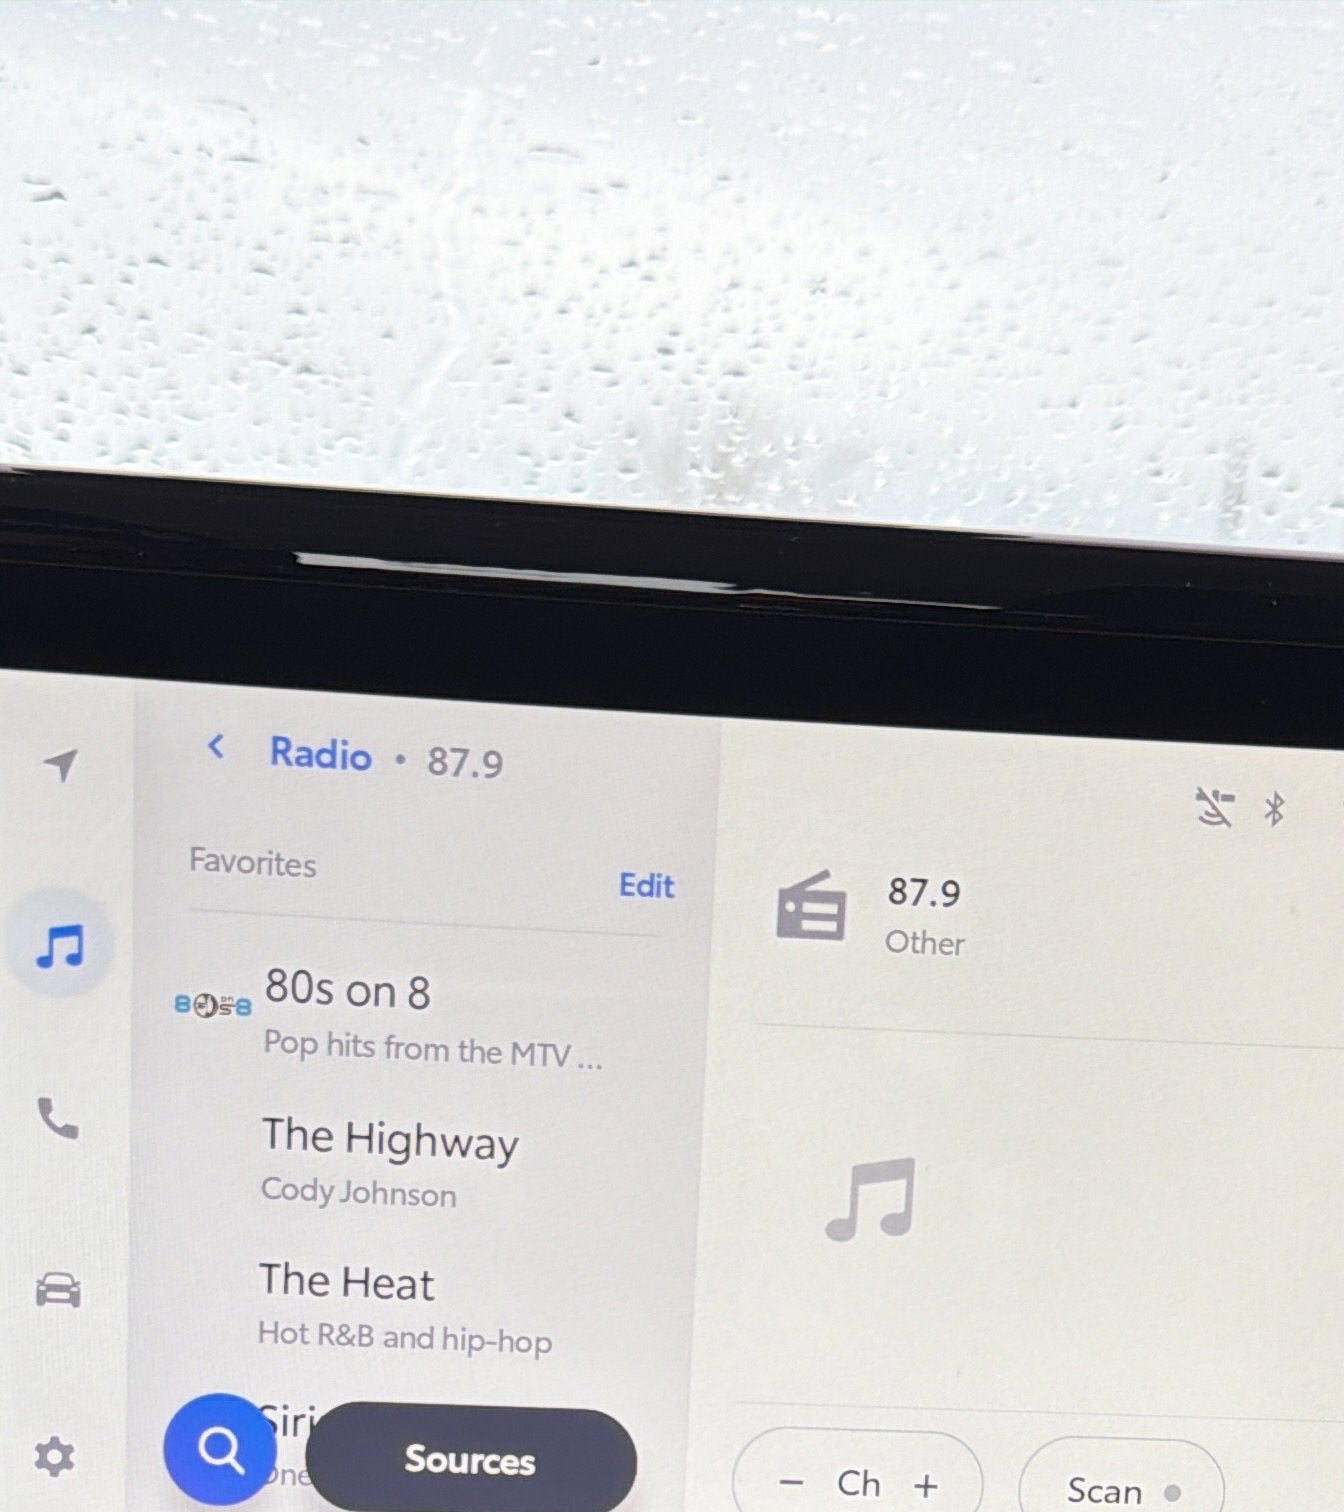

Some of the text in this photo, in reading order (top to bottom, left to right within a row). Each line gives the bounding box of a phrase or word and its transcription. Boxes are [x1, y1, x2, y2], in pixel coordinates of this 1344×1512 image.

[269, 735, 504, 779] Radio 87.9
[189, 846, 318, 879] Favorites
[619, 873, 676, 899] Edit
[888, 877, 962, 908] 87.9
[885, 929, 965, 957] Other
[265, 968, 431, 1010] 80s on 8
[264, 1030, 318, 1062] Pop
[327, 1031, 375, 1061] hits
[384, 1034, 450, 1063] from
[458, 1037, 503, 1066] the
[511, 1041, 573, 1069] MTV
[263, 1117, 520, 1168] The Highway
[261, 1176, 458, 1209] Cody Johnson
[259, 1262, 436, 1302] The Heat
[258, 1320, 553, 1358] Hot R&B and hip-hop
[405, 1443, 537, 1478] Sources
[837, 1469, 881, 1499] Ch
[1067, 1476, 1143, 1506] Scan
